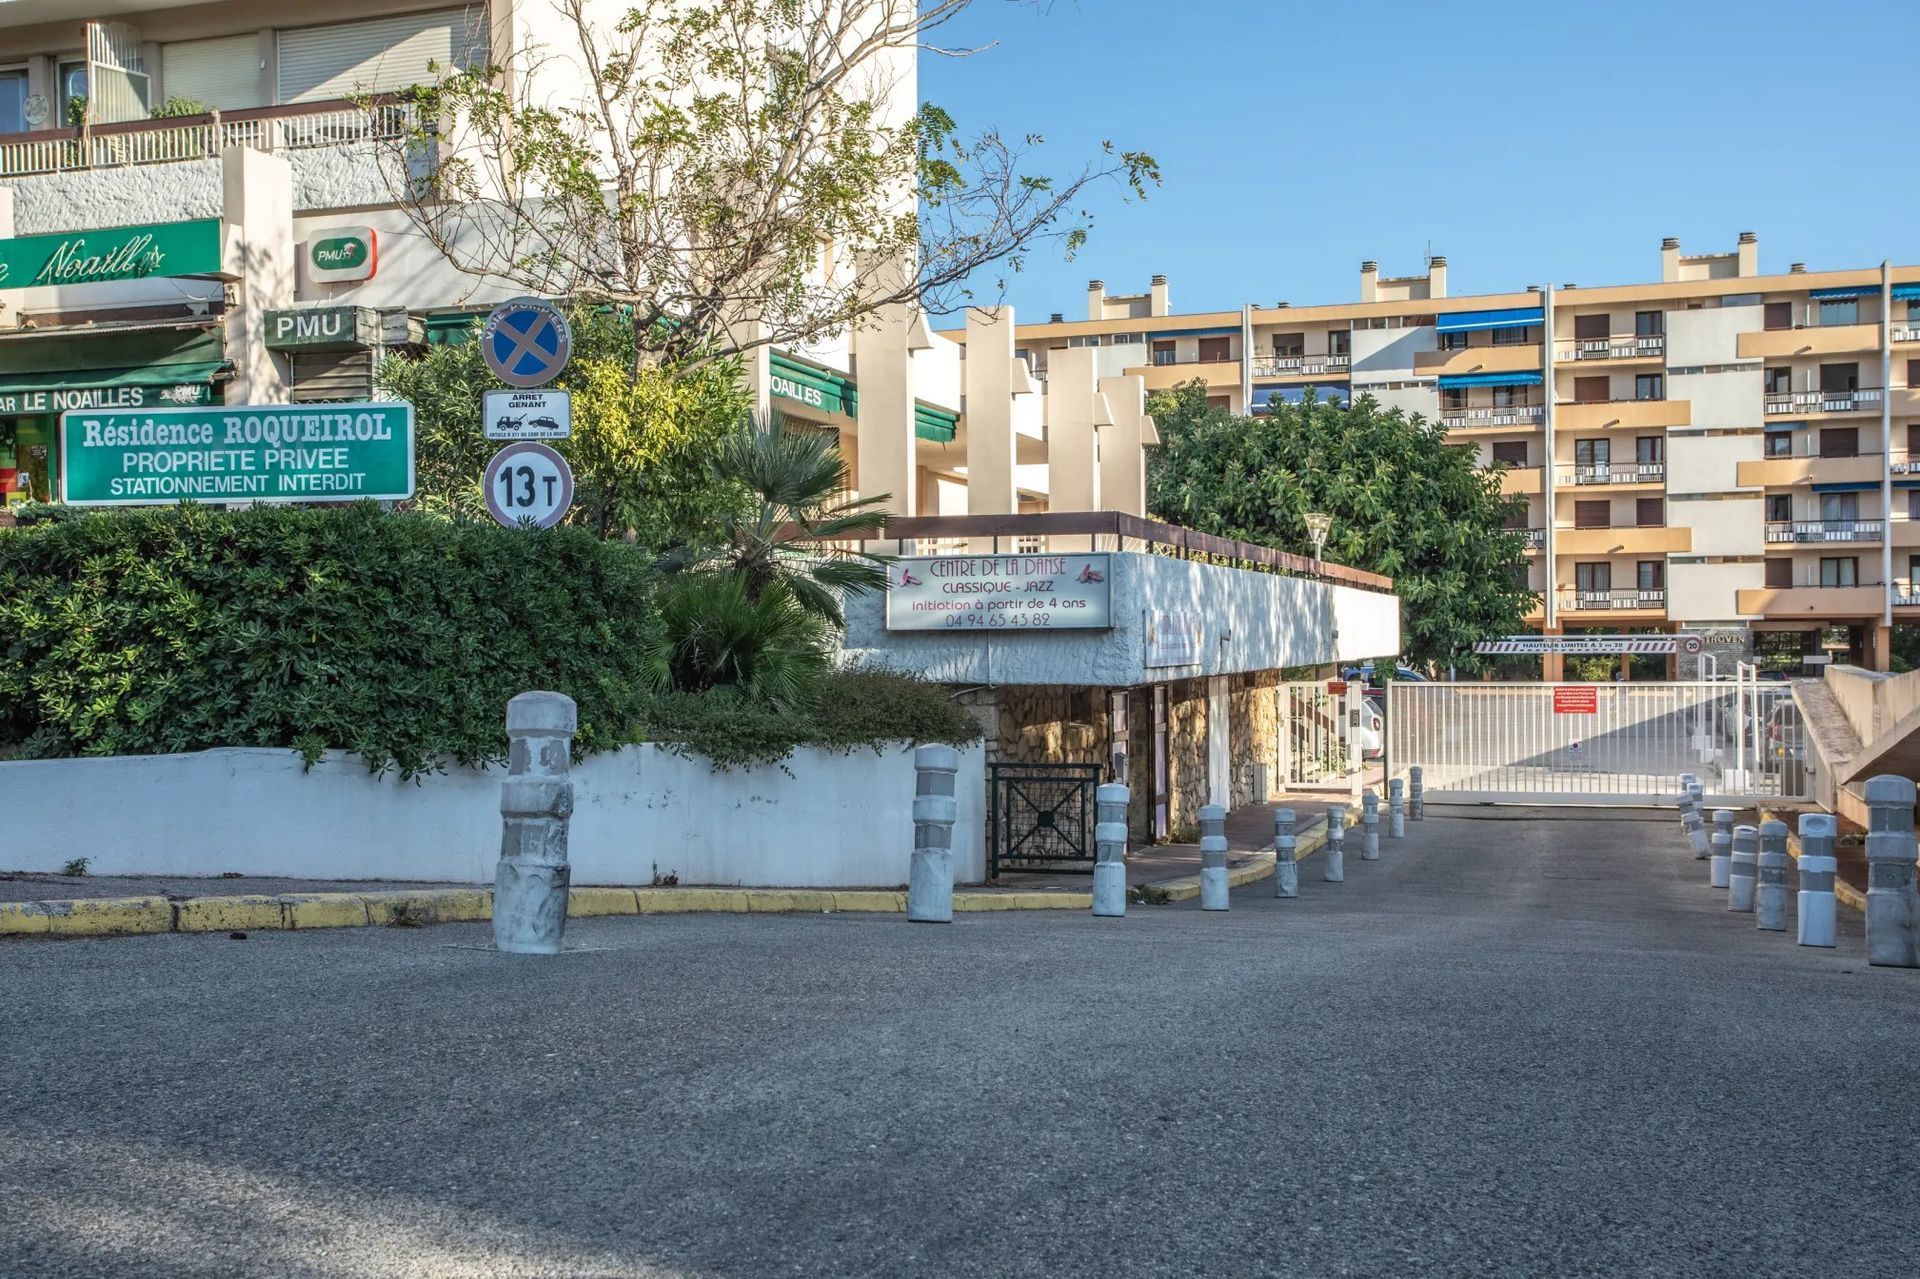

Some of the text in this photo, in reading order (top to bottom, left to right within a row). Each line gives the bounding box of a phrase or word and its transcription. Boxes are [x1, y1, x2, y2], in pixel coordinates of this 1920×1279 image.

[318, 250, 342, 262] PMU
[0, 263, 9, 282] e
[277, 313, 341, 339] PMU
[0, 396, 16, 412] AR
[24, 391, 47, 411] LE
[53, 386, 144, 410] NOAILLES
[769, 374, 822, 406] OAILLES
[82, 413, 392, 448] Résidence ROQUEIROL
[123, 448, 349, 473] PROPRIETE PRIVEE
[110, 473, 366, 495] STATIONNEMENT INTERDIT
[930, 557, 1066, 577] CENTRE DE LA DANSE
[942, 581, 1011, 595] CLASSIQUE
[1024, 581, 1054, 592] JAZZ
[974, 598, 984, 610] à
[987, 599, 1024, 612] partir
[1027, 598, 1045, 609] de
[1049, 598, 1057, 607] 4
[1062, 599, 1086, 608] ans
[945, 613, 1050, 627] 04 94 65 43 82
